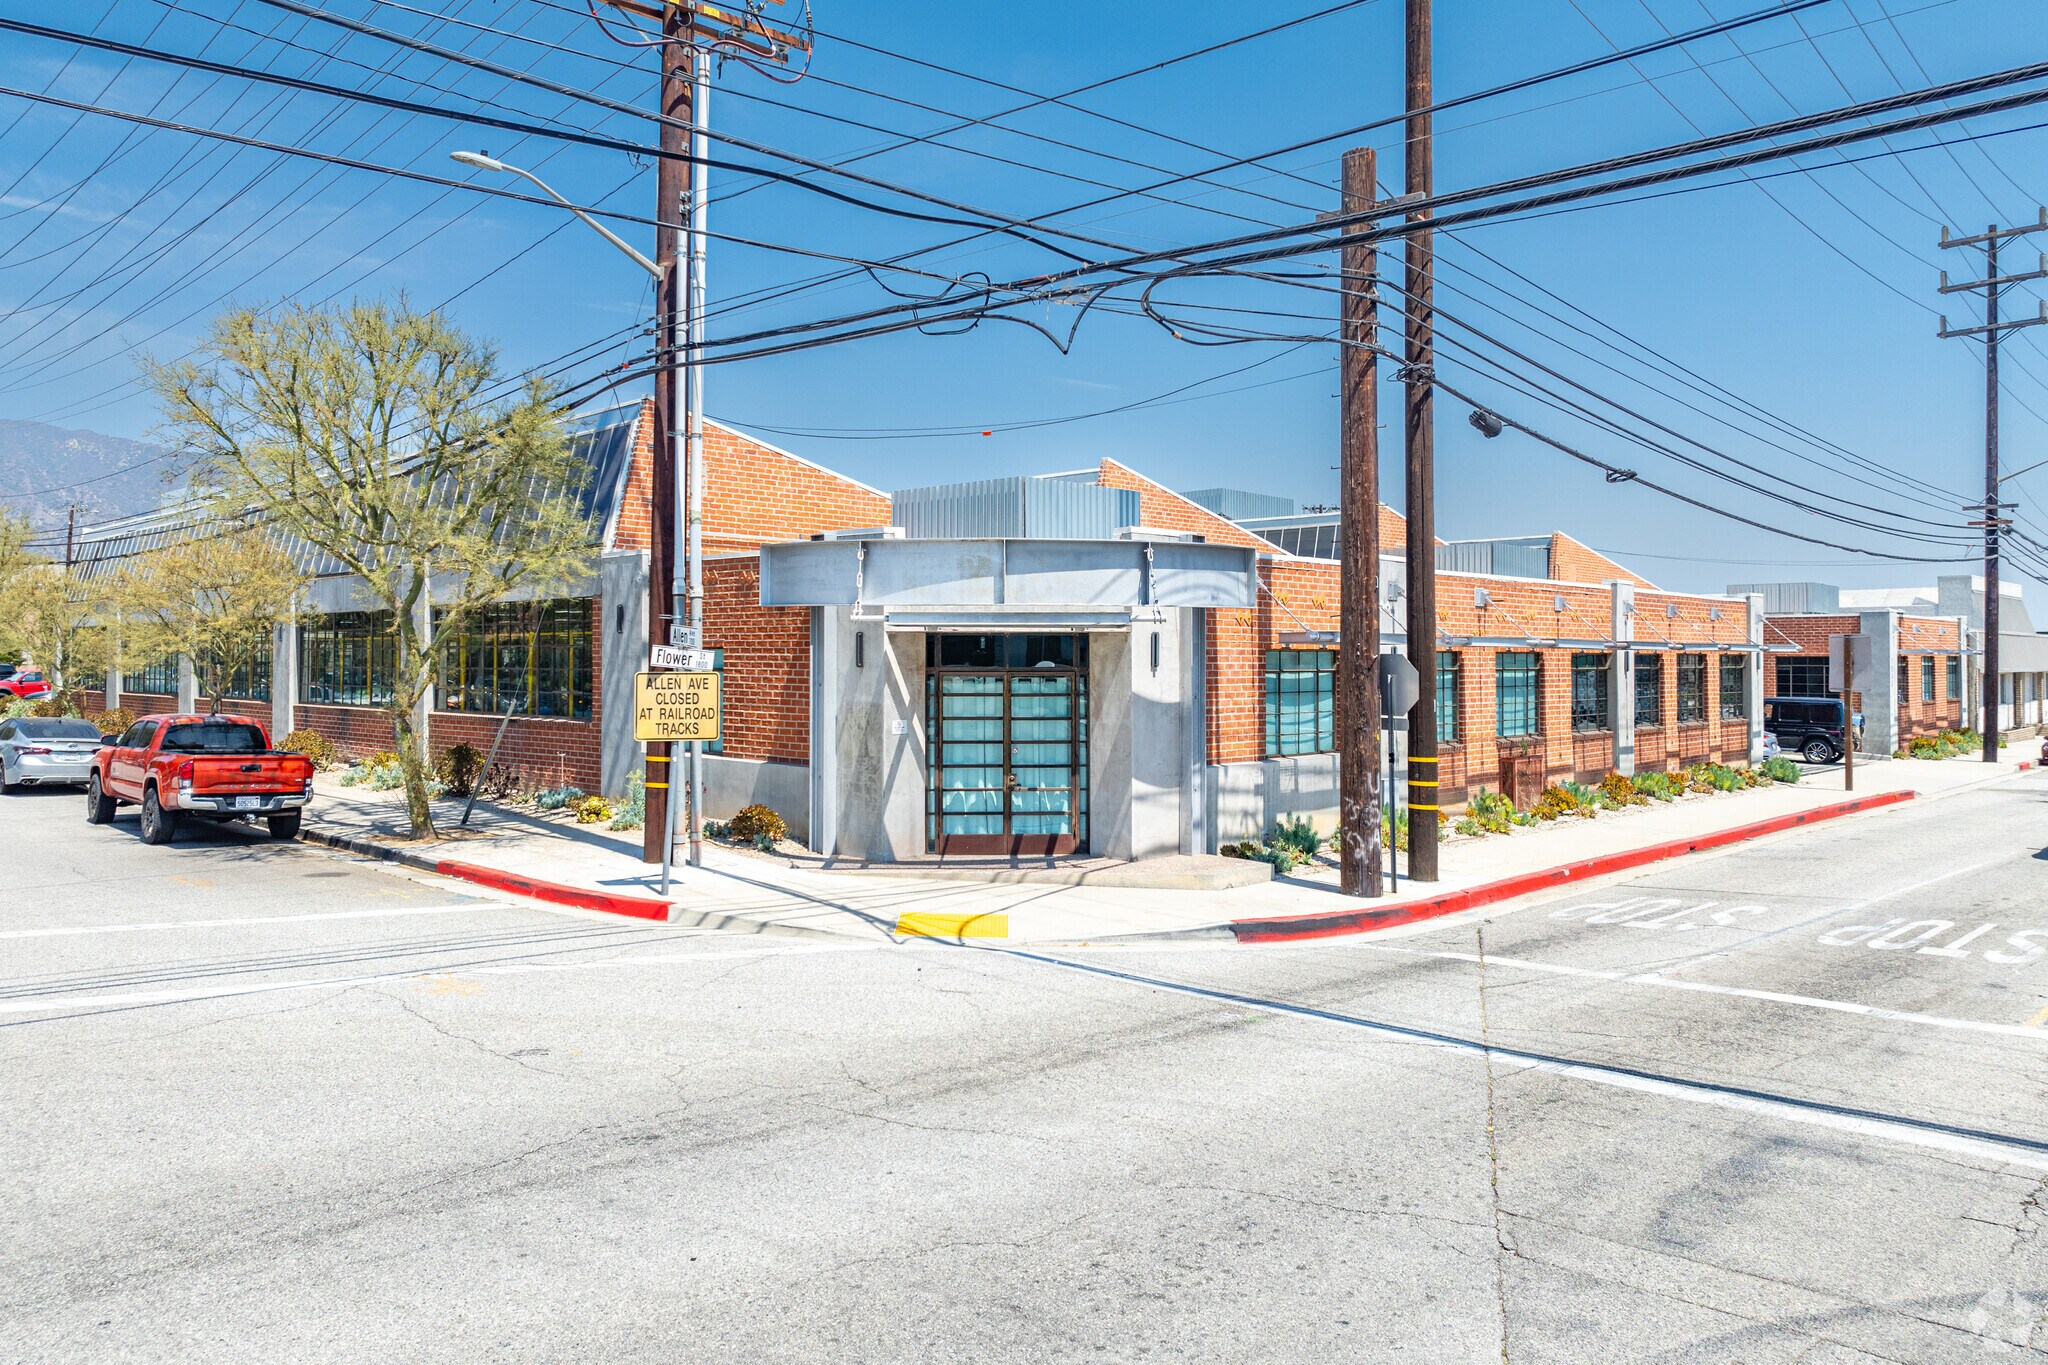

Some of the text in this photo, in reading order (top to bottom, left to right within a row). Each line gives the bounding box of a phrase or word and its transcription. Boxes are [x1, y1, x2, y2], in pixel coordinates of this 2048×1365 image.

[673, 627, 688, 644] Allen
[656, 649, 706, 667] Flower St
[646, 677, 709, 690] ALLEN AVE
[655, 692, 700, 705] CLOSED
[639, 707, 715, 720] AT RAILROAD
[655, 722, 699, 735] TRACKS
[1816, 917, 2048, 963] STOP
